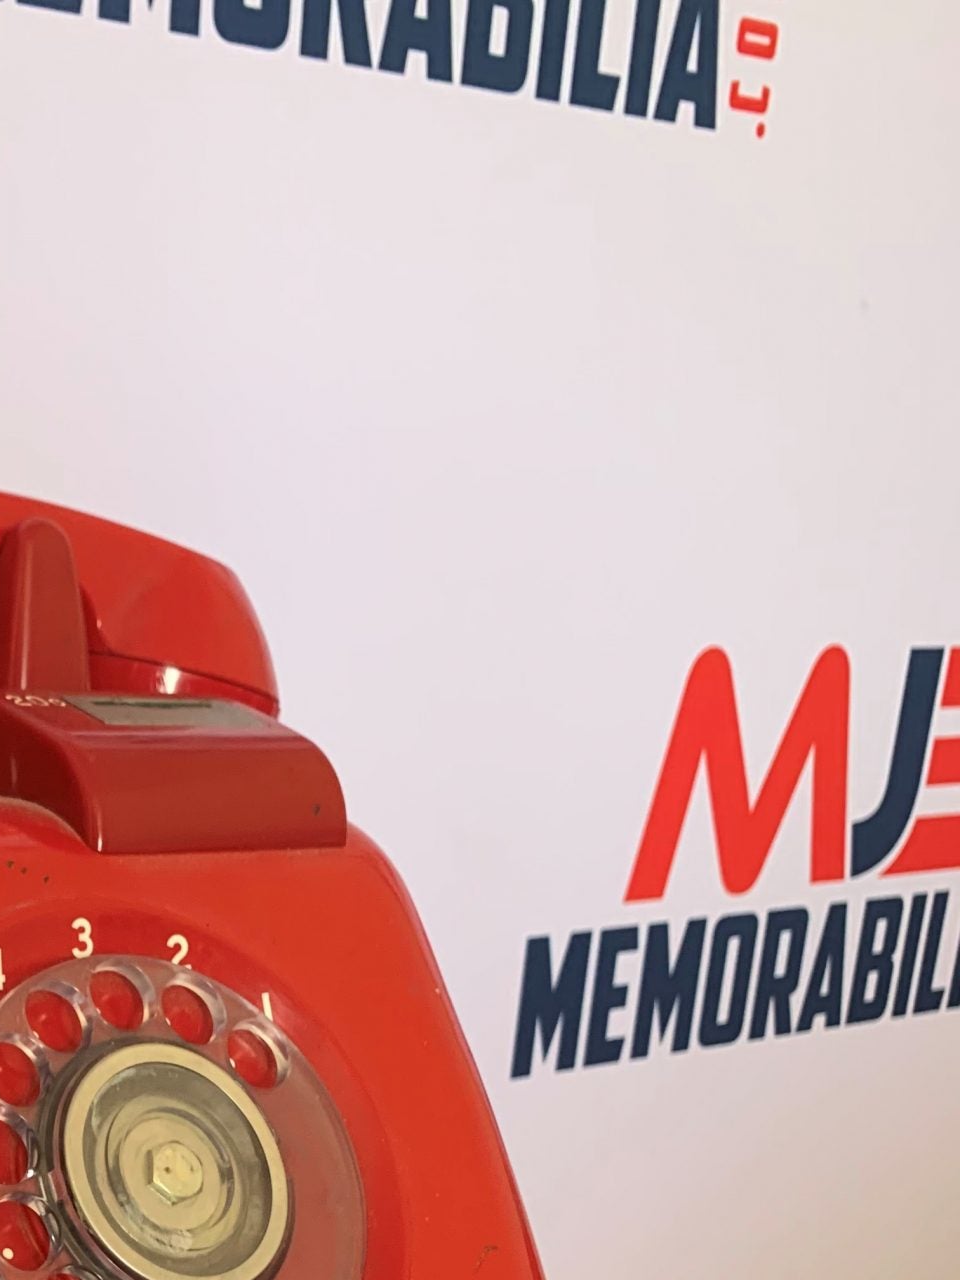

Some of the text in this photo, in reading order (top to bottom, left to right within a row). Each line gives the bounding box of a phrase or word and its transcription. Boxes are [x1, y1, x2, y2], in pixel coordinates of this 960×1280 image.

[71, 917, 95, 959] 3
[166, 933, 192, 970] 2
[261, 992, 274, 1022] 1
